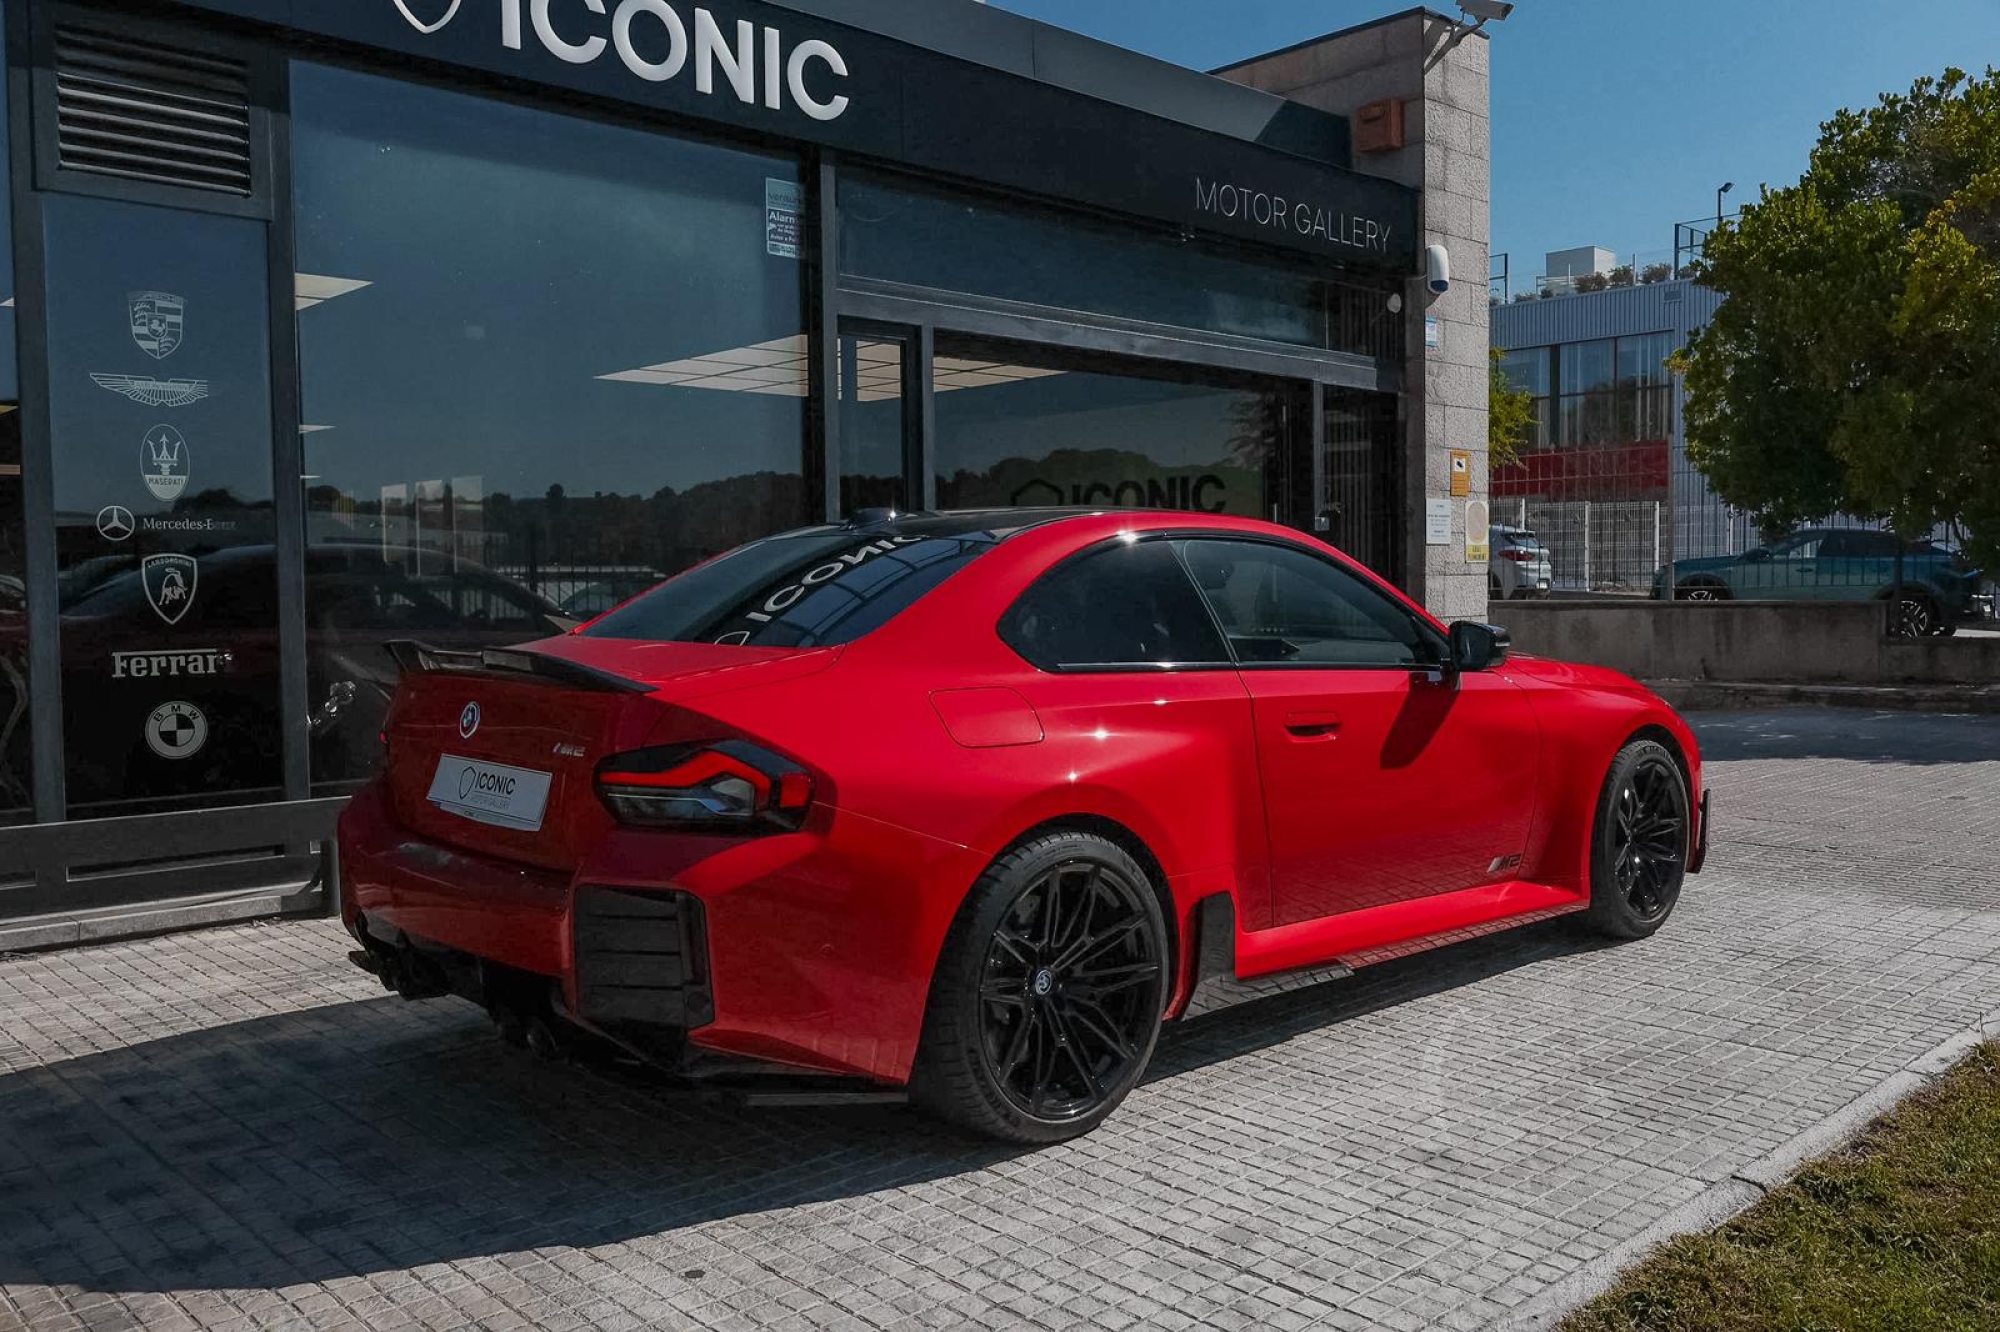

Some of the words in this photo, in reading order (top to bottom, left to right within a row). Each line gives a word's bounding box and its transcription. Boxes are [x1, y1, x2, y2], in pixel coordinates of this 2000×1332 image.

[502, 0, 849, 120] ICONIC
[1195, 176, 1287, 229] MOTOR
[1294, 203, 1391, 252] GALLERY
[111, 649, 219, 677] Ferrar
[475, 772, 516, 795] ICONIC
